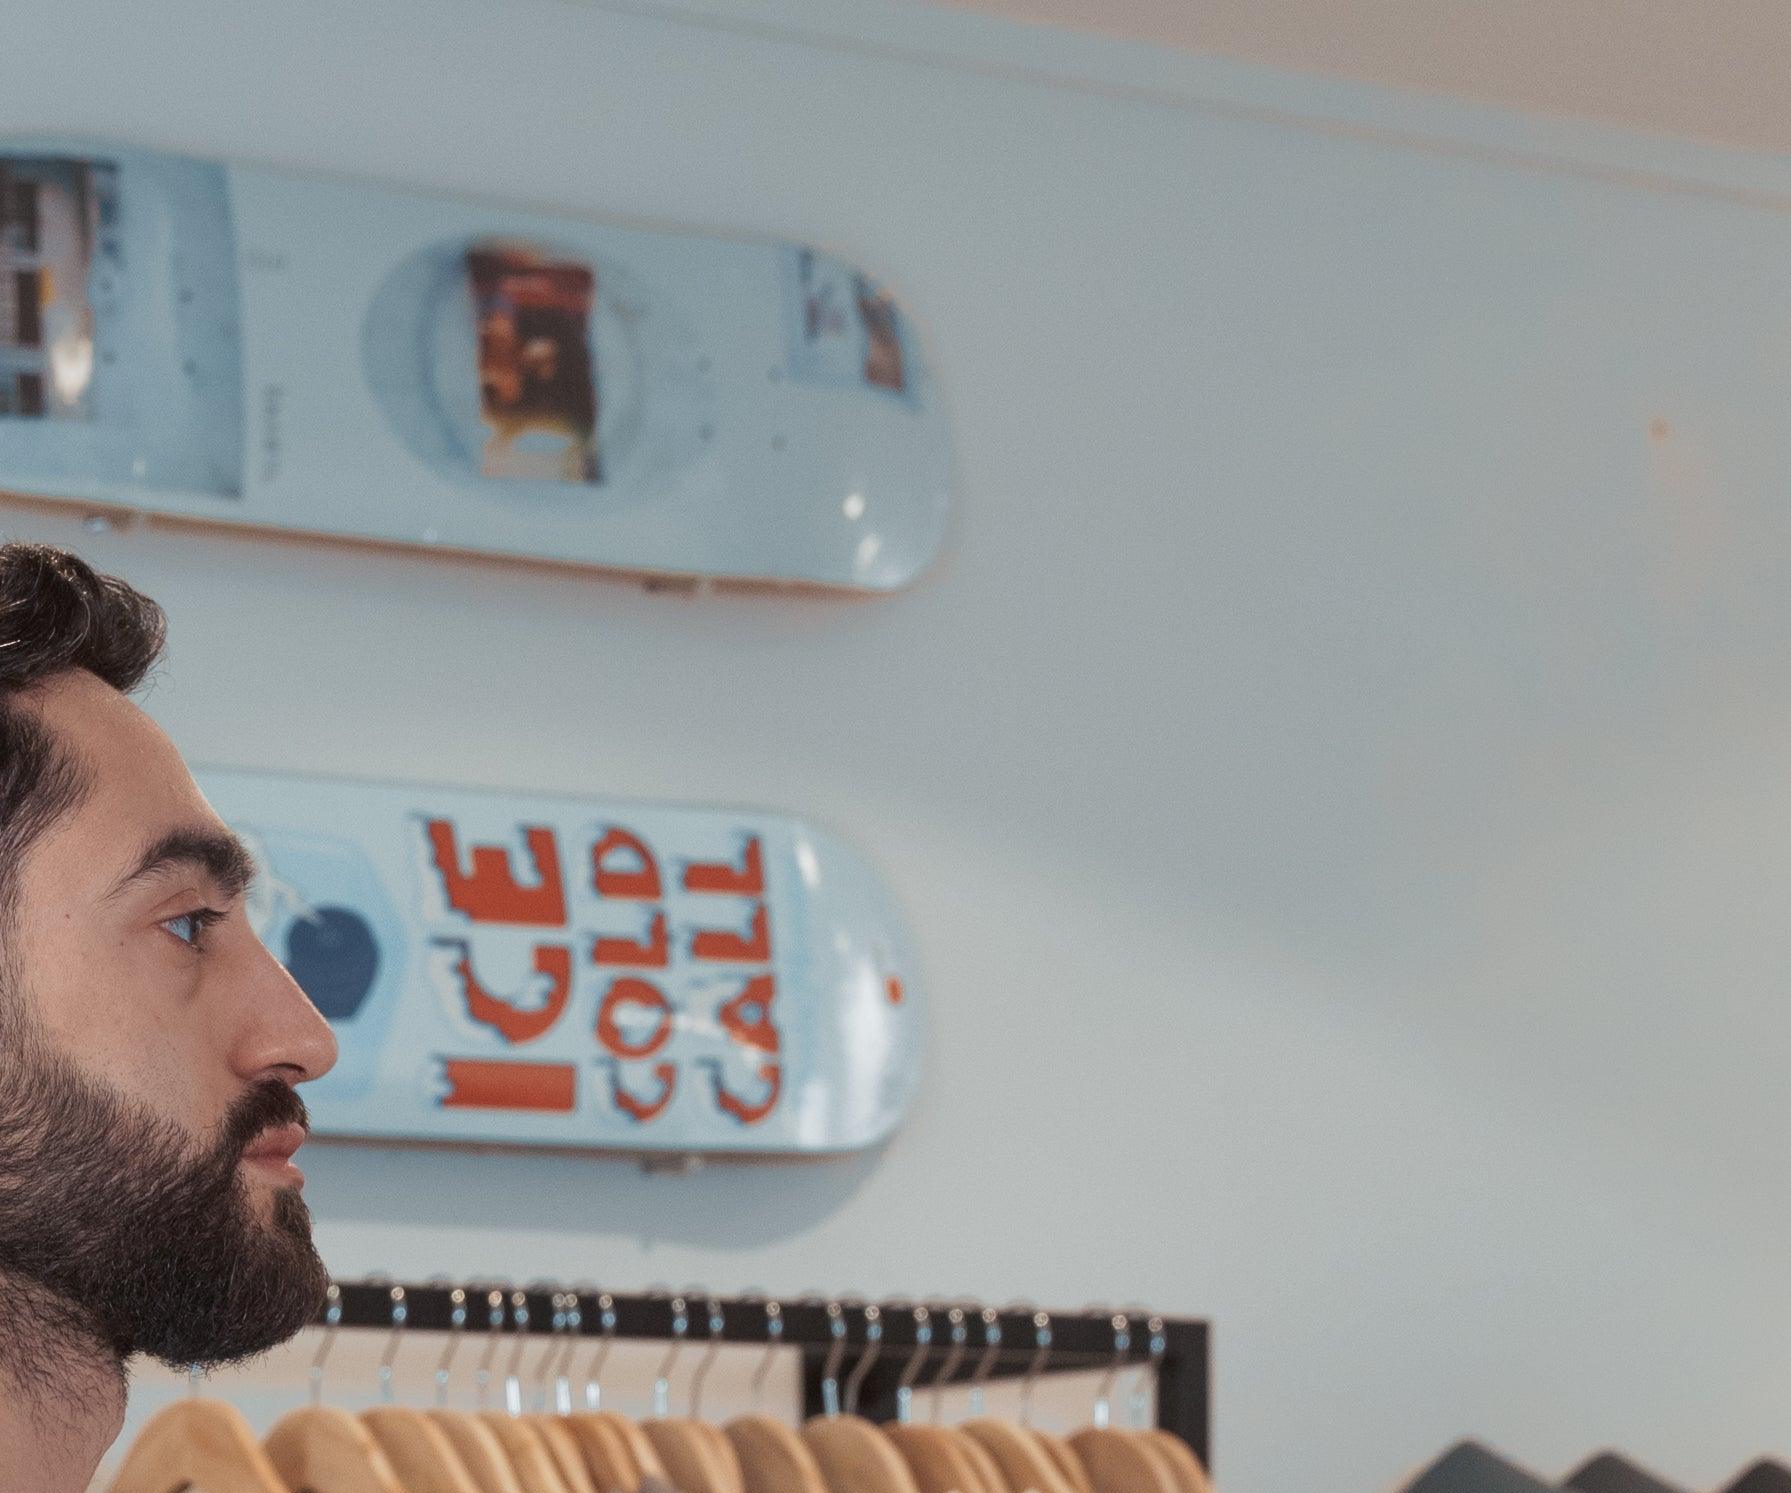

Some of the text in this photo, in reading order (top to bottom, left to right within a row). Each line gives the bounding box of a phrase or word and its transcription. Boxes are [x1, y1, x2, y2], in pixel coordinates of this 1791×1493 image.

[423, 817, 577, 1115] ICE
[591, 827, 677, 1124] COLD
[682, 835, 782, 1125] CALL
